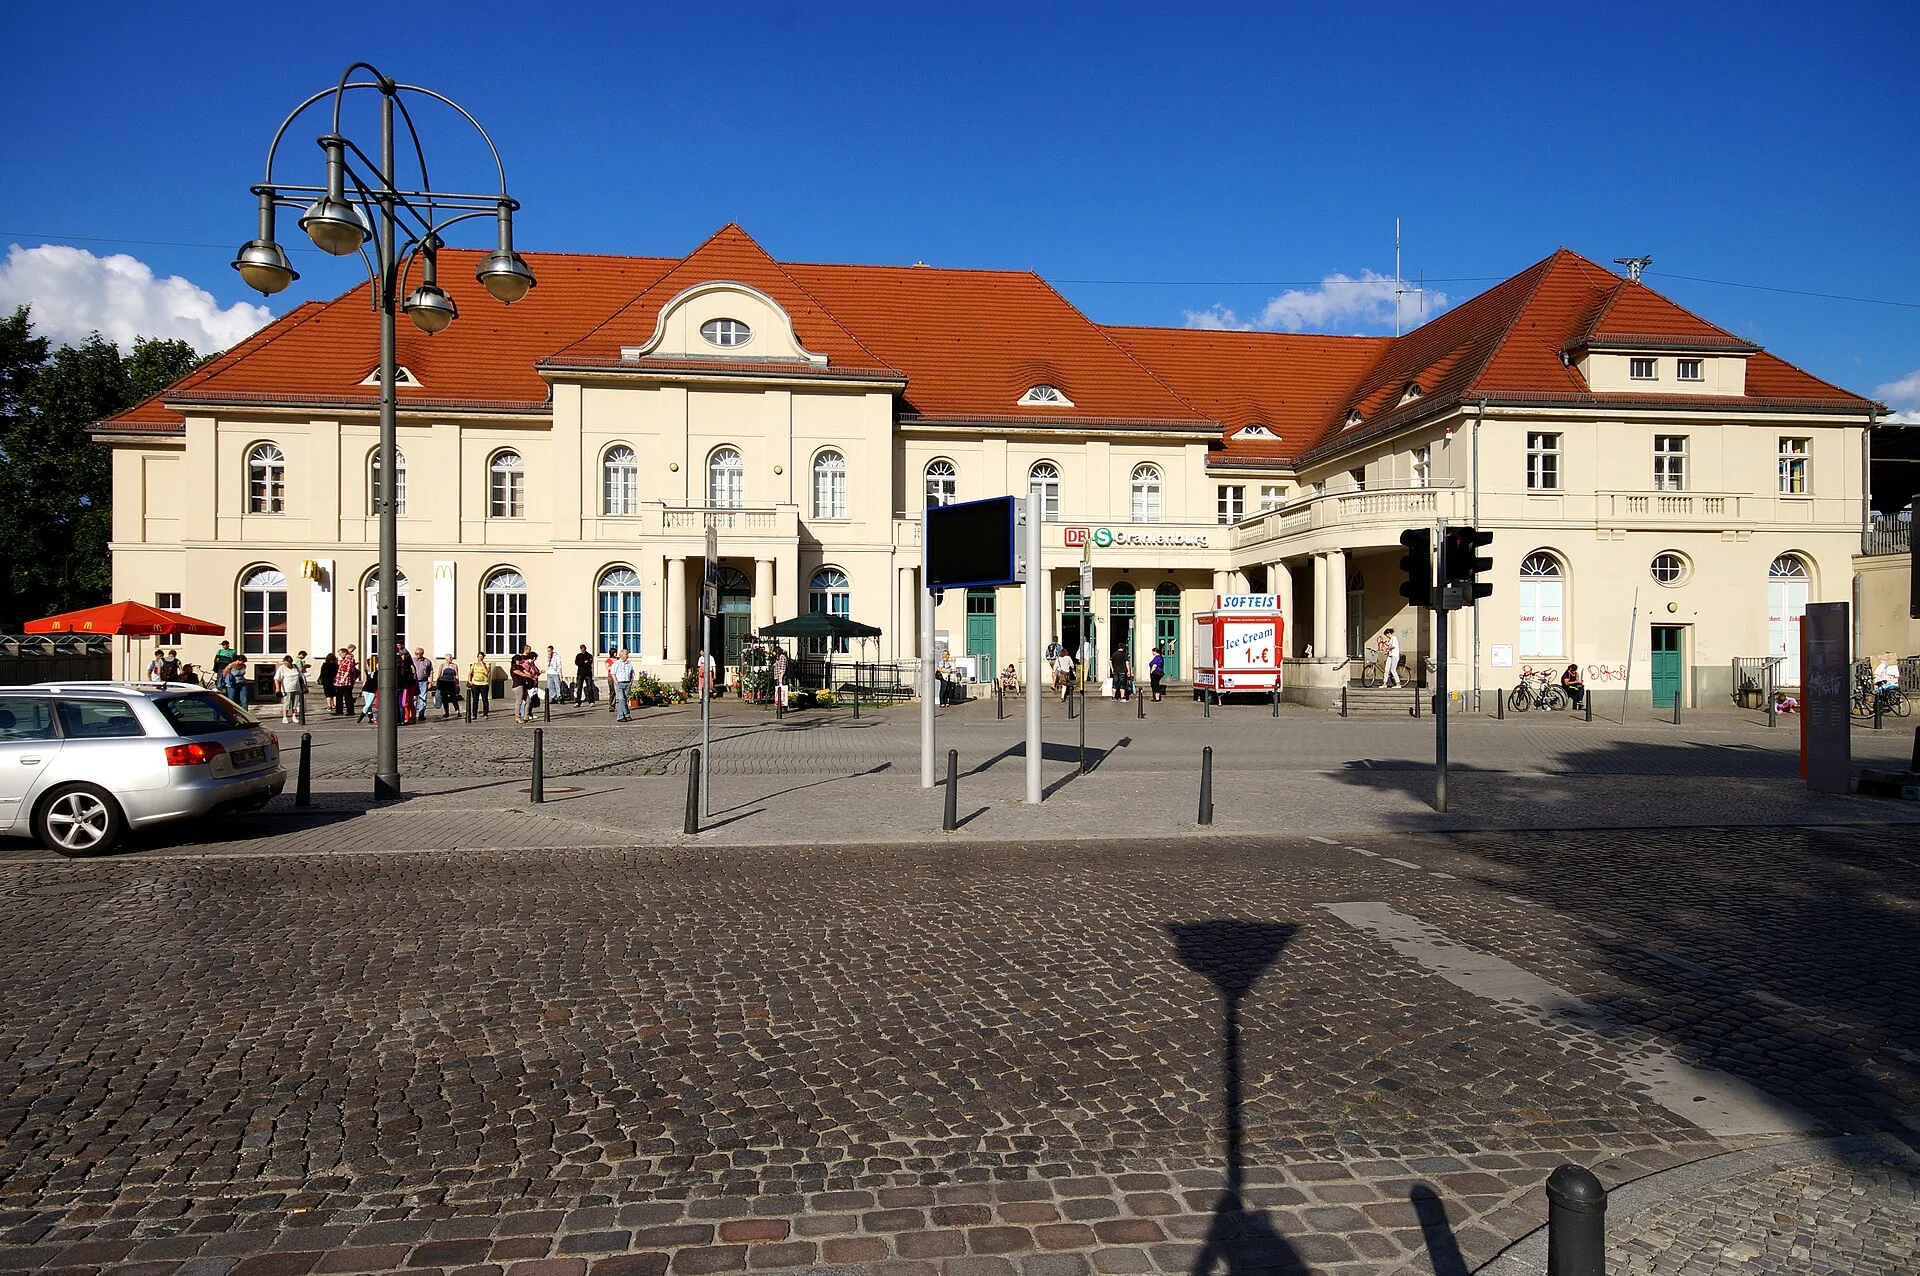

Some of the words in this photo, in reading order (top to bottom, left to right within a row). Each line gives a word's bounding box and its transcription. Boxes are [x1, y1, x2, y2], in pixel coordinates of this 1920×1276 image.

[1067, 530, 1087, 543] DB
[1095, 529, 1110, 545] S
[1115, 532, 1209, 549] Oranienburg
[1223, 596, 1275, 608] SOFTEIS
[1225, 638, 1240, 650] Ice
[1242, 628, 1273, 644] Cream
